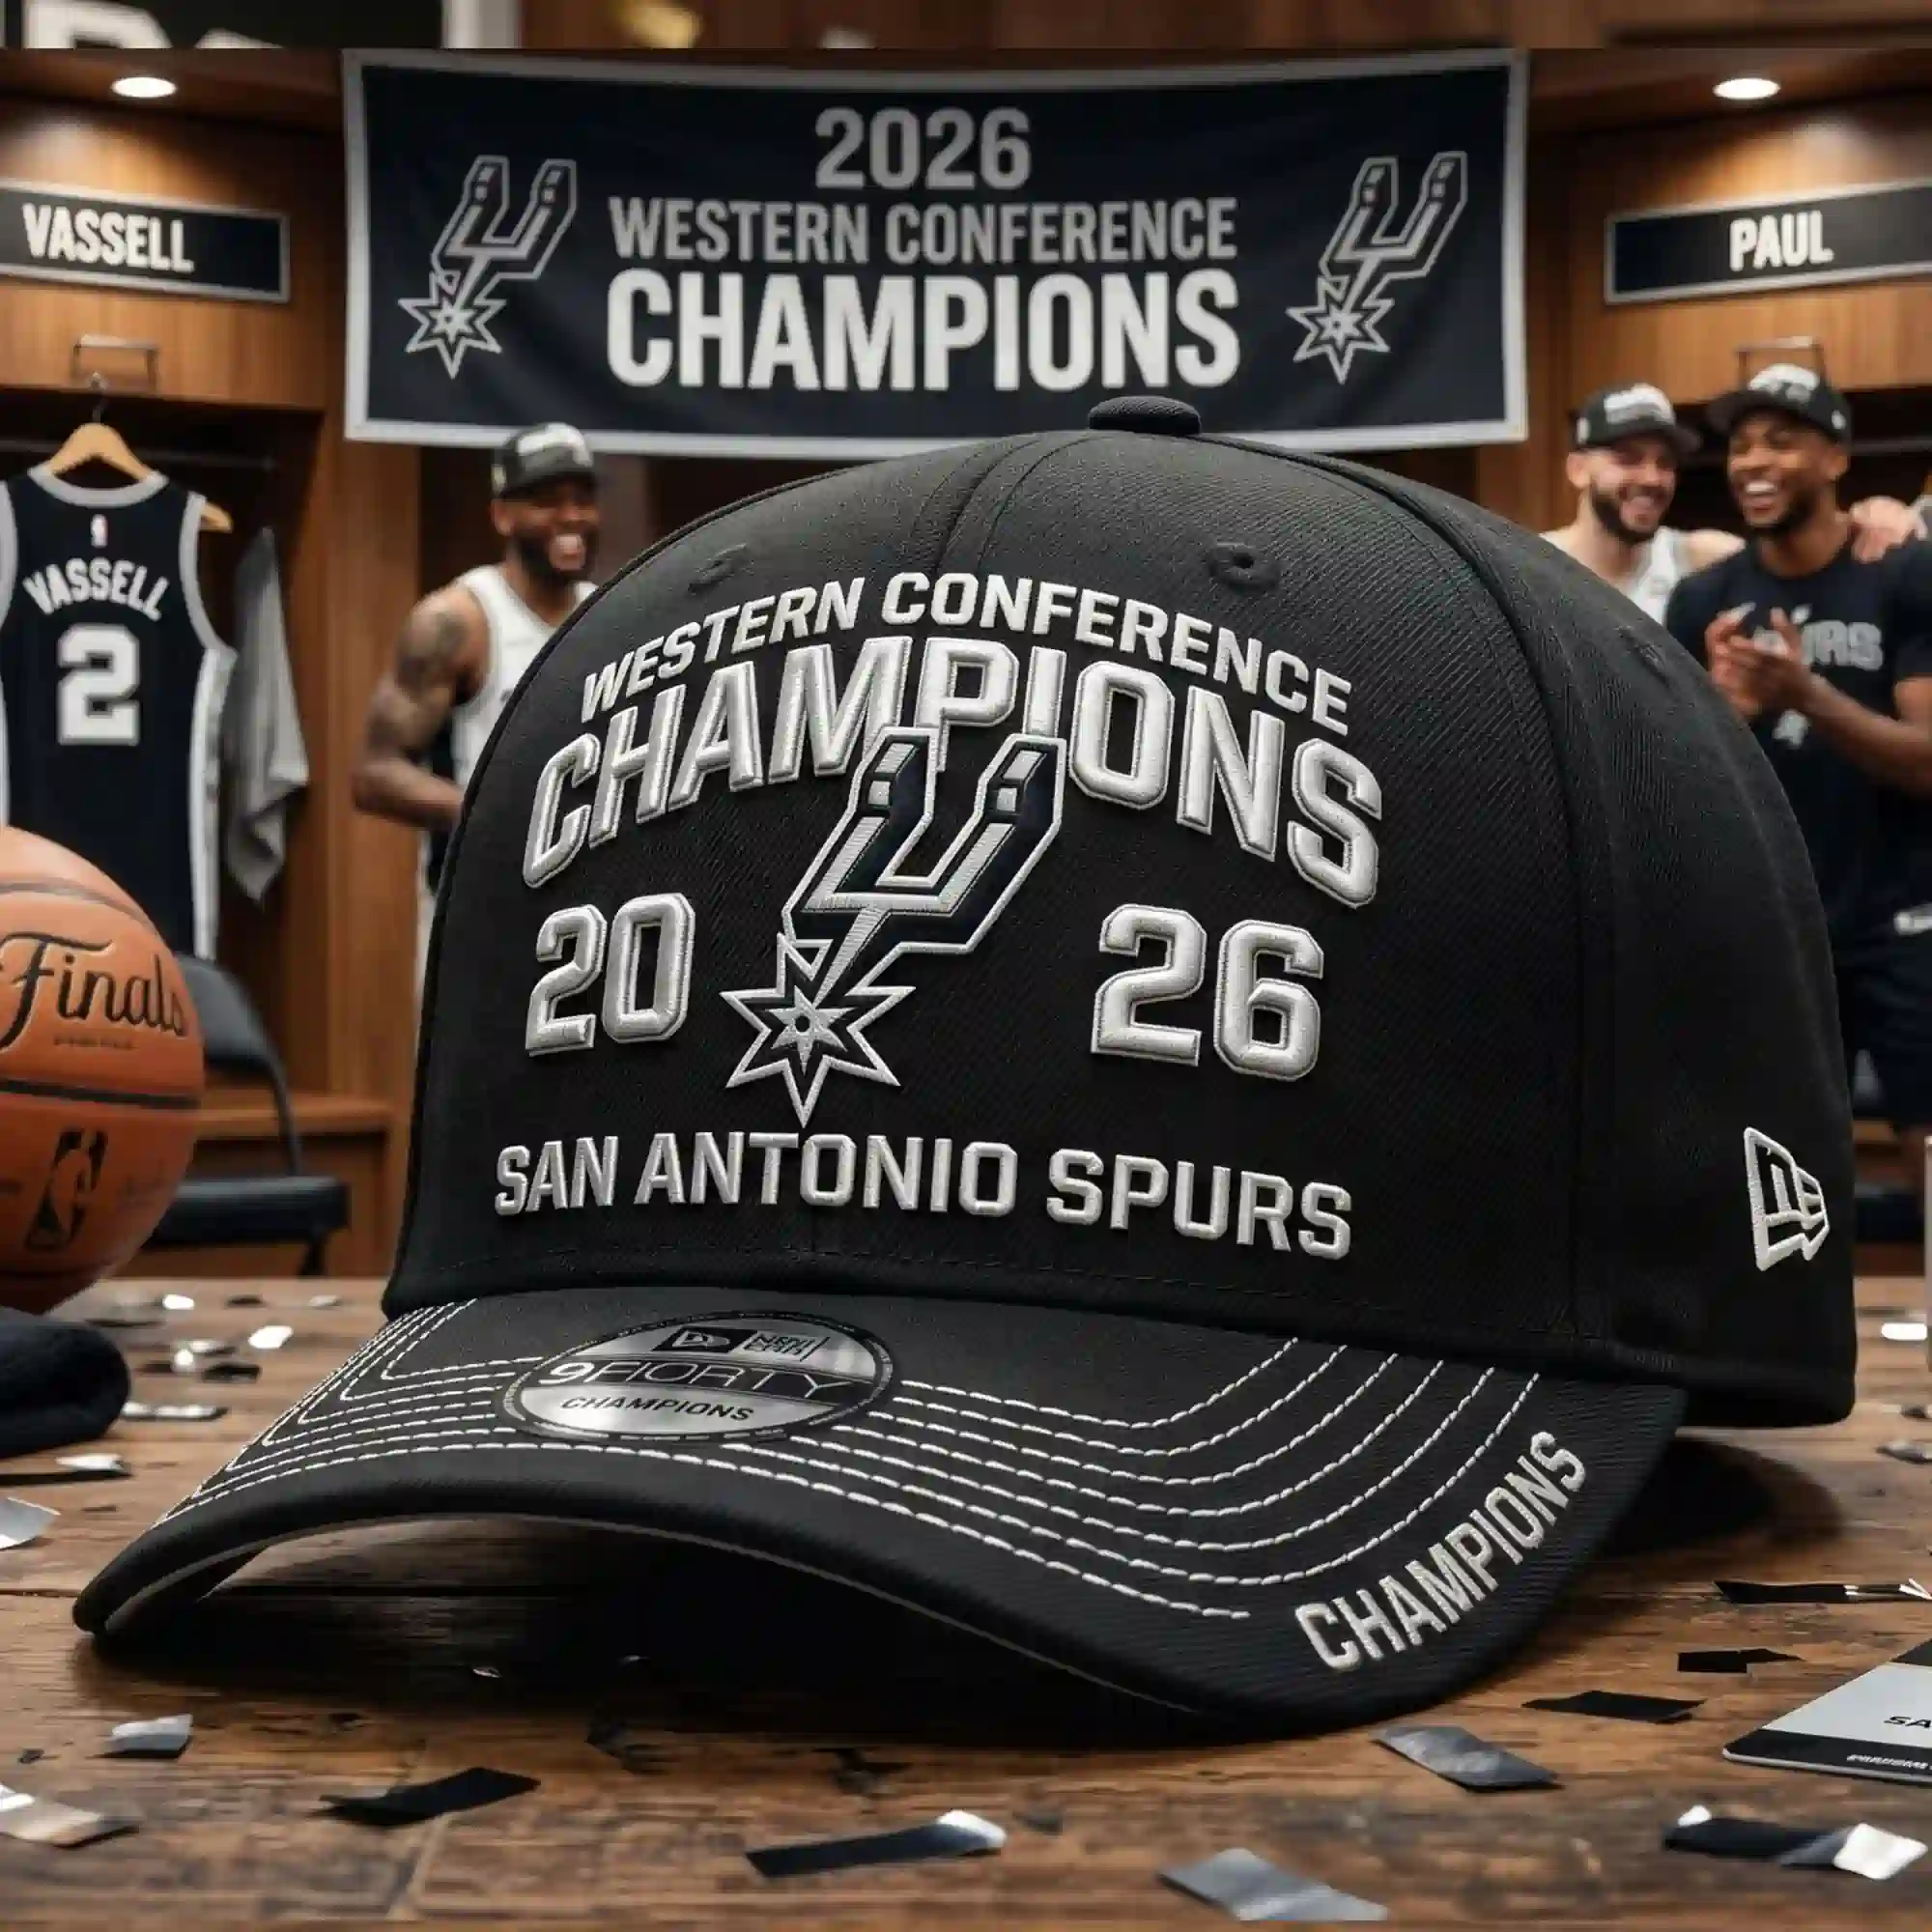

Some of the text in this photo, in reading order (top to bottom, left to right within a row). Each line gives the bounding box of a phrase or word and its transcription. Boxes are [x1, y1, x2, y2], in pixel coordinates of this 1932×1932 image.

[814, 107, 1032, 190] 2026
[21, 203, 195, 272] VASSELL
[608, 196, 1237, 266] WESTERN CONFERENCE
[1729, 211, 1834, 272] PAUL
[606, 267, 1240, 391] CHAMPIONS
[22, 557, 170, 621] VASSELL
[57, 622, 140, 746] 2
[581, 572, 1352, 736] WESTERN CONFERENCE
[523, 636, 1382, 909] CHAMPIONS
[0, 932, 188, 1052] Finals
[525, 893, 1324, 1082] 20 26
[495, 1131, 1352, 1260] SAN ANTONIO SPURS
[560, 1396, 753, 1421] CHAMPIONS
[1294, 1432, 1586, 1670] CHAMPIONS
